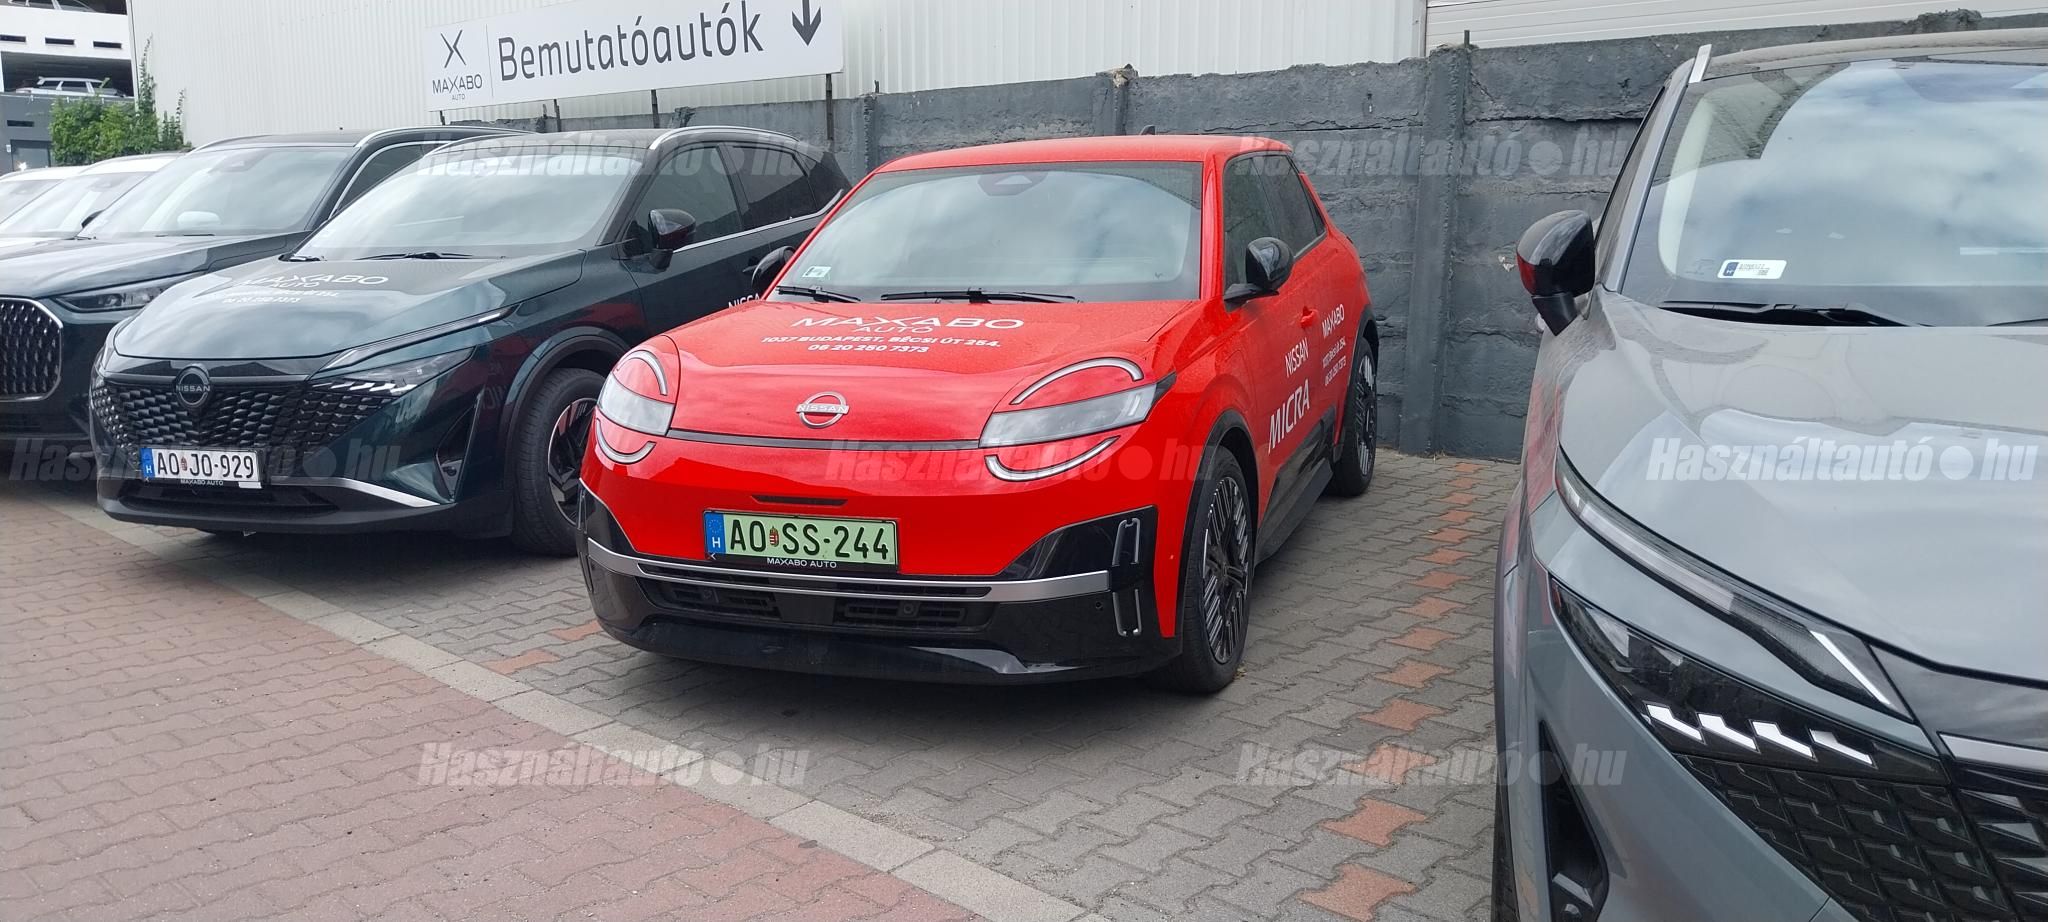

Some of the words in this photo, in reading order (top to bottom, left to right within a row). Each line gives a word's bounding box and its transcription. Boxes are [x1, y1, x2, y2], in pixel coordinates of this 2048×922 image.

[498, 0, 764, 82] Bemutatóautók
[432, 74, 483, 94] MAXABO
[452, 93, 466, 101] AUTO
[791, 316, 1025, 329] MAXABO
[1321, 303, 1345, 339] MAXABO
[852, 326, 934, 334] AUTO
[888, 345, 929, 353] 7373
[1284, 337, 1309, 378] NISSAN
[798, 404, 848, 414] NISSAN
[1267, 378, 1310, 457] MICRA
[712, 536, 721, 549] H
[766, 557, 808, 567] MAXABO
[809, 559, 837, 569] AUTO
